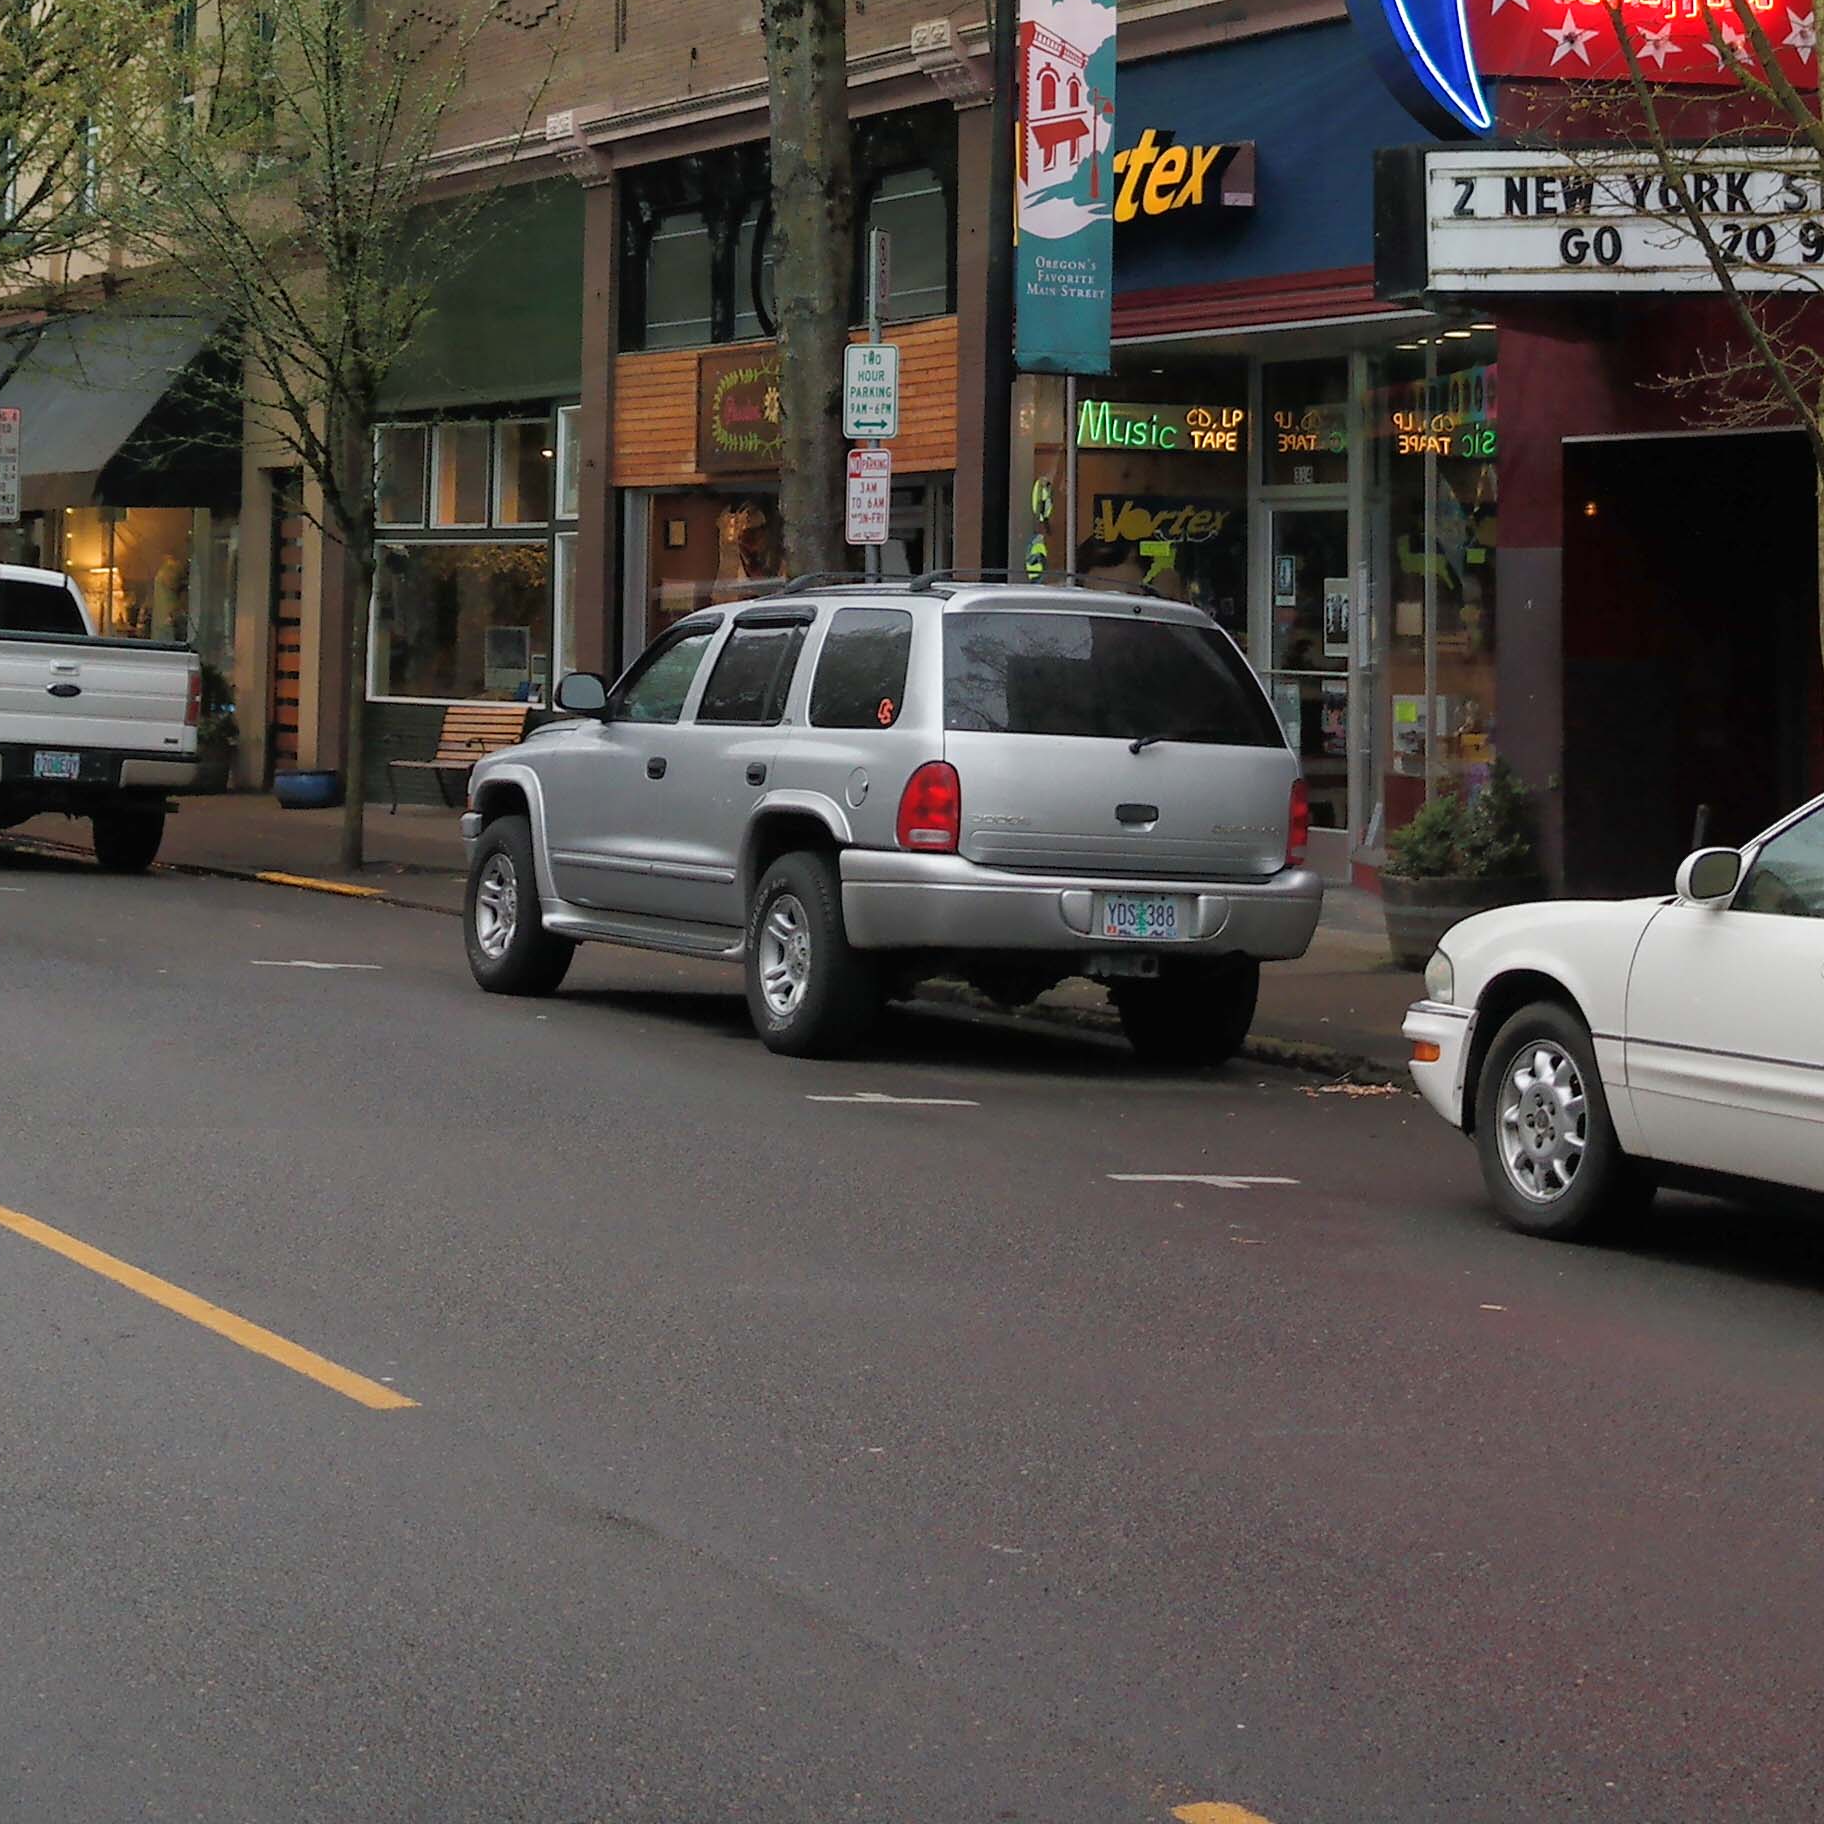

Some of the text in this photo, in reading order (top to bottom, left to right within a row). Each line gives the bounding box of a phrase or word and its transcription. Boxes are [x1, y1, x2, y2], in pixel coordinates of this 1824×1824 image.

[1504, 175, 1597, 216] NEW
[1560, 225, 1624, 266] GO
[1038, 270, 1095, 285] FAVORITE
[1026, 282, 1106, 299] MAIN STREET
[857, 370, 885, 382] HOUR
[850, 386, 893, 398] PARKING
[1077, 399, 1177, 448] Music
[1222, 409, 1243, 427] LP
[1190, 430, 1238, 452] TAPE
[851, 497, 862, 509] TO
